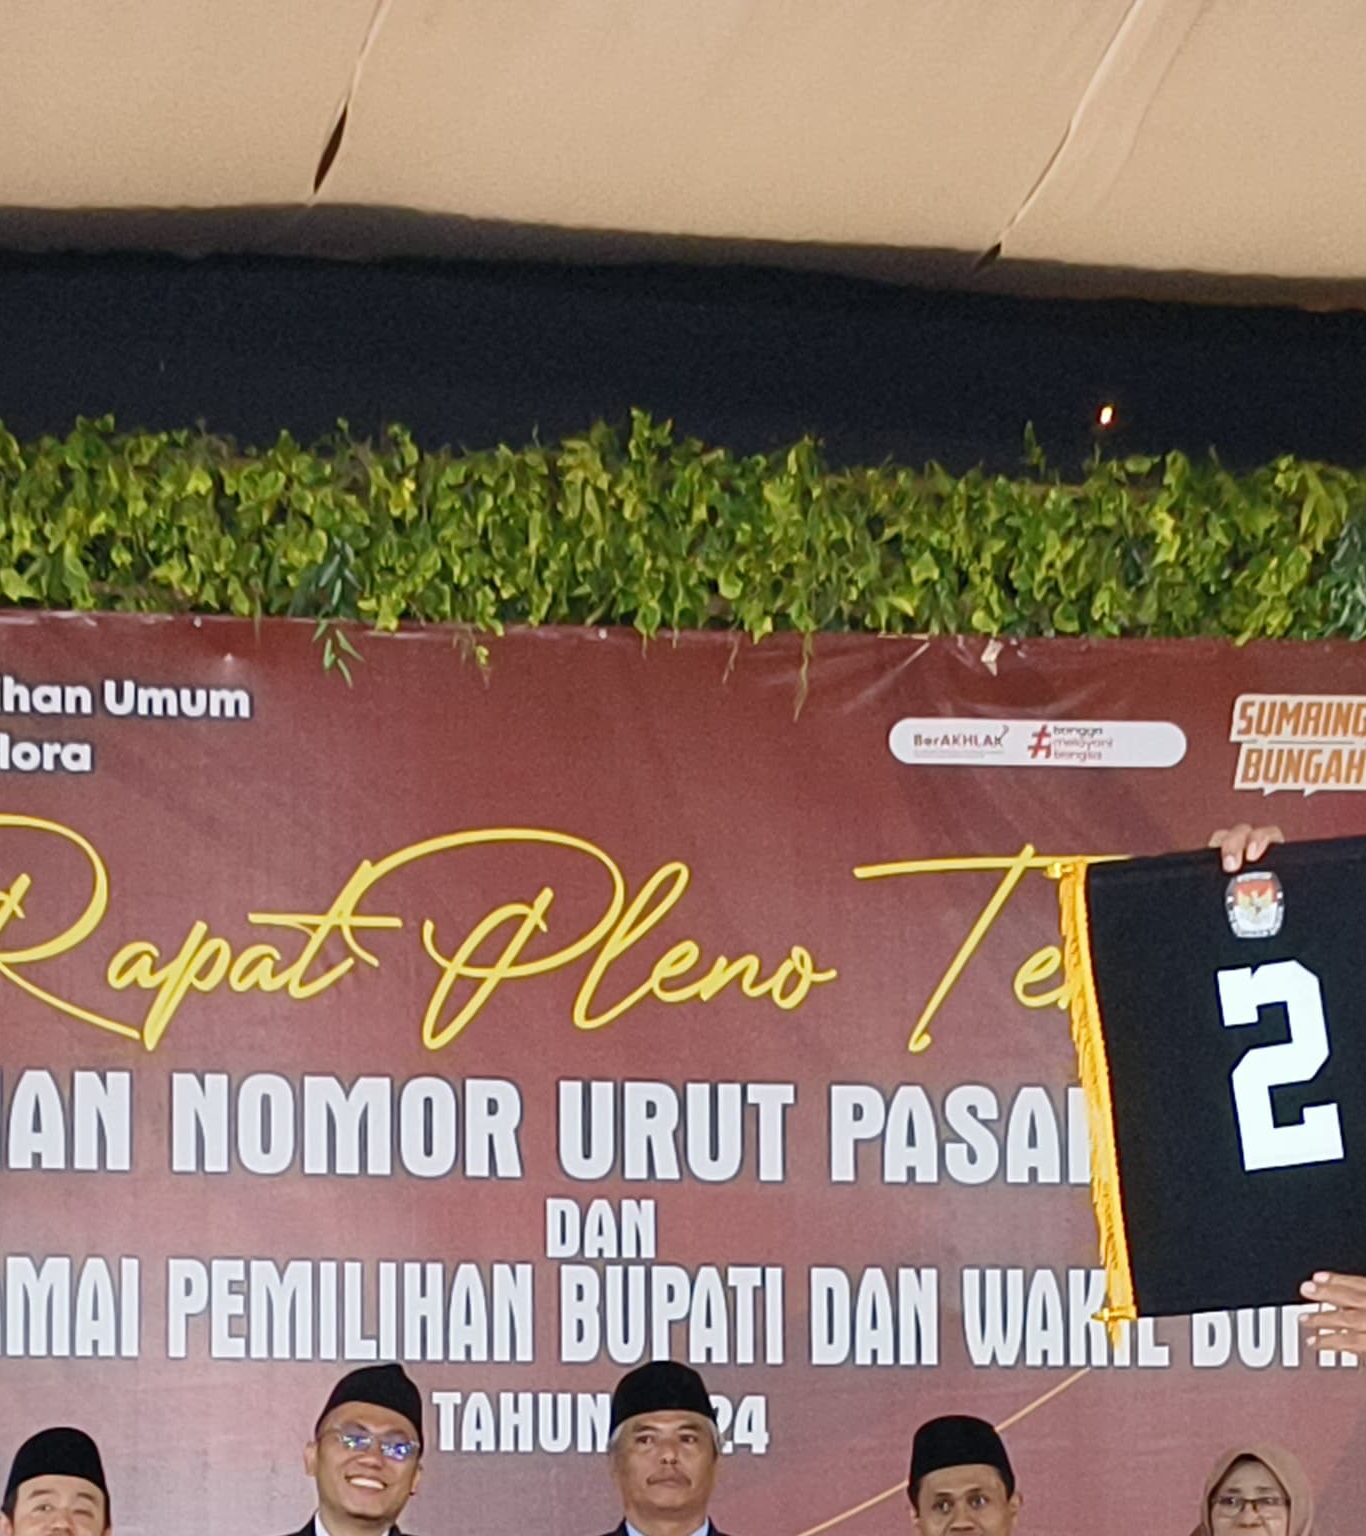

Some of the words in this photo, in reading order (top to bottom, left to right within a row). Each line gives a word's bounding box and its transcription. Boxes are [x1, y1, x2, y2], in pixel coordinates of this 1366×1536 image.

[103, 680, 252, 719] Umum
[1242, 749, 1366, 784] BUNGAH
[334, 829, 838, 1048] Pleno
[1217, 960, 1344, 1171] 2
[171, 1072, 522, 1179] NOMOR
[559, 1080, 794, 1182] URUT
[546, 1198, 655, 1259] DAN
[167, 1258, 533, 1361] PEMILIHAN
[560, 1265, 784, 1365] BUPATI
[810, 1267, 938, 1366] DAN
[432, 1391, 611, 1453] TAHUN
